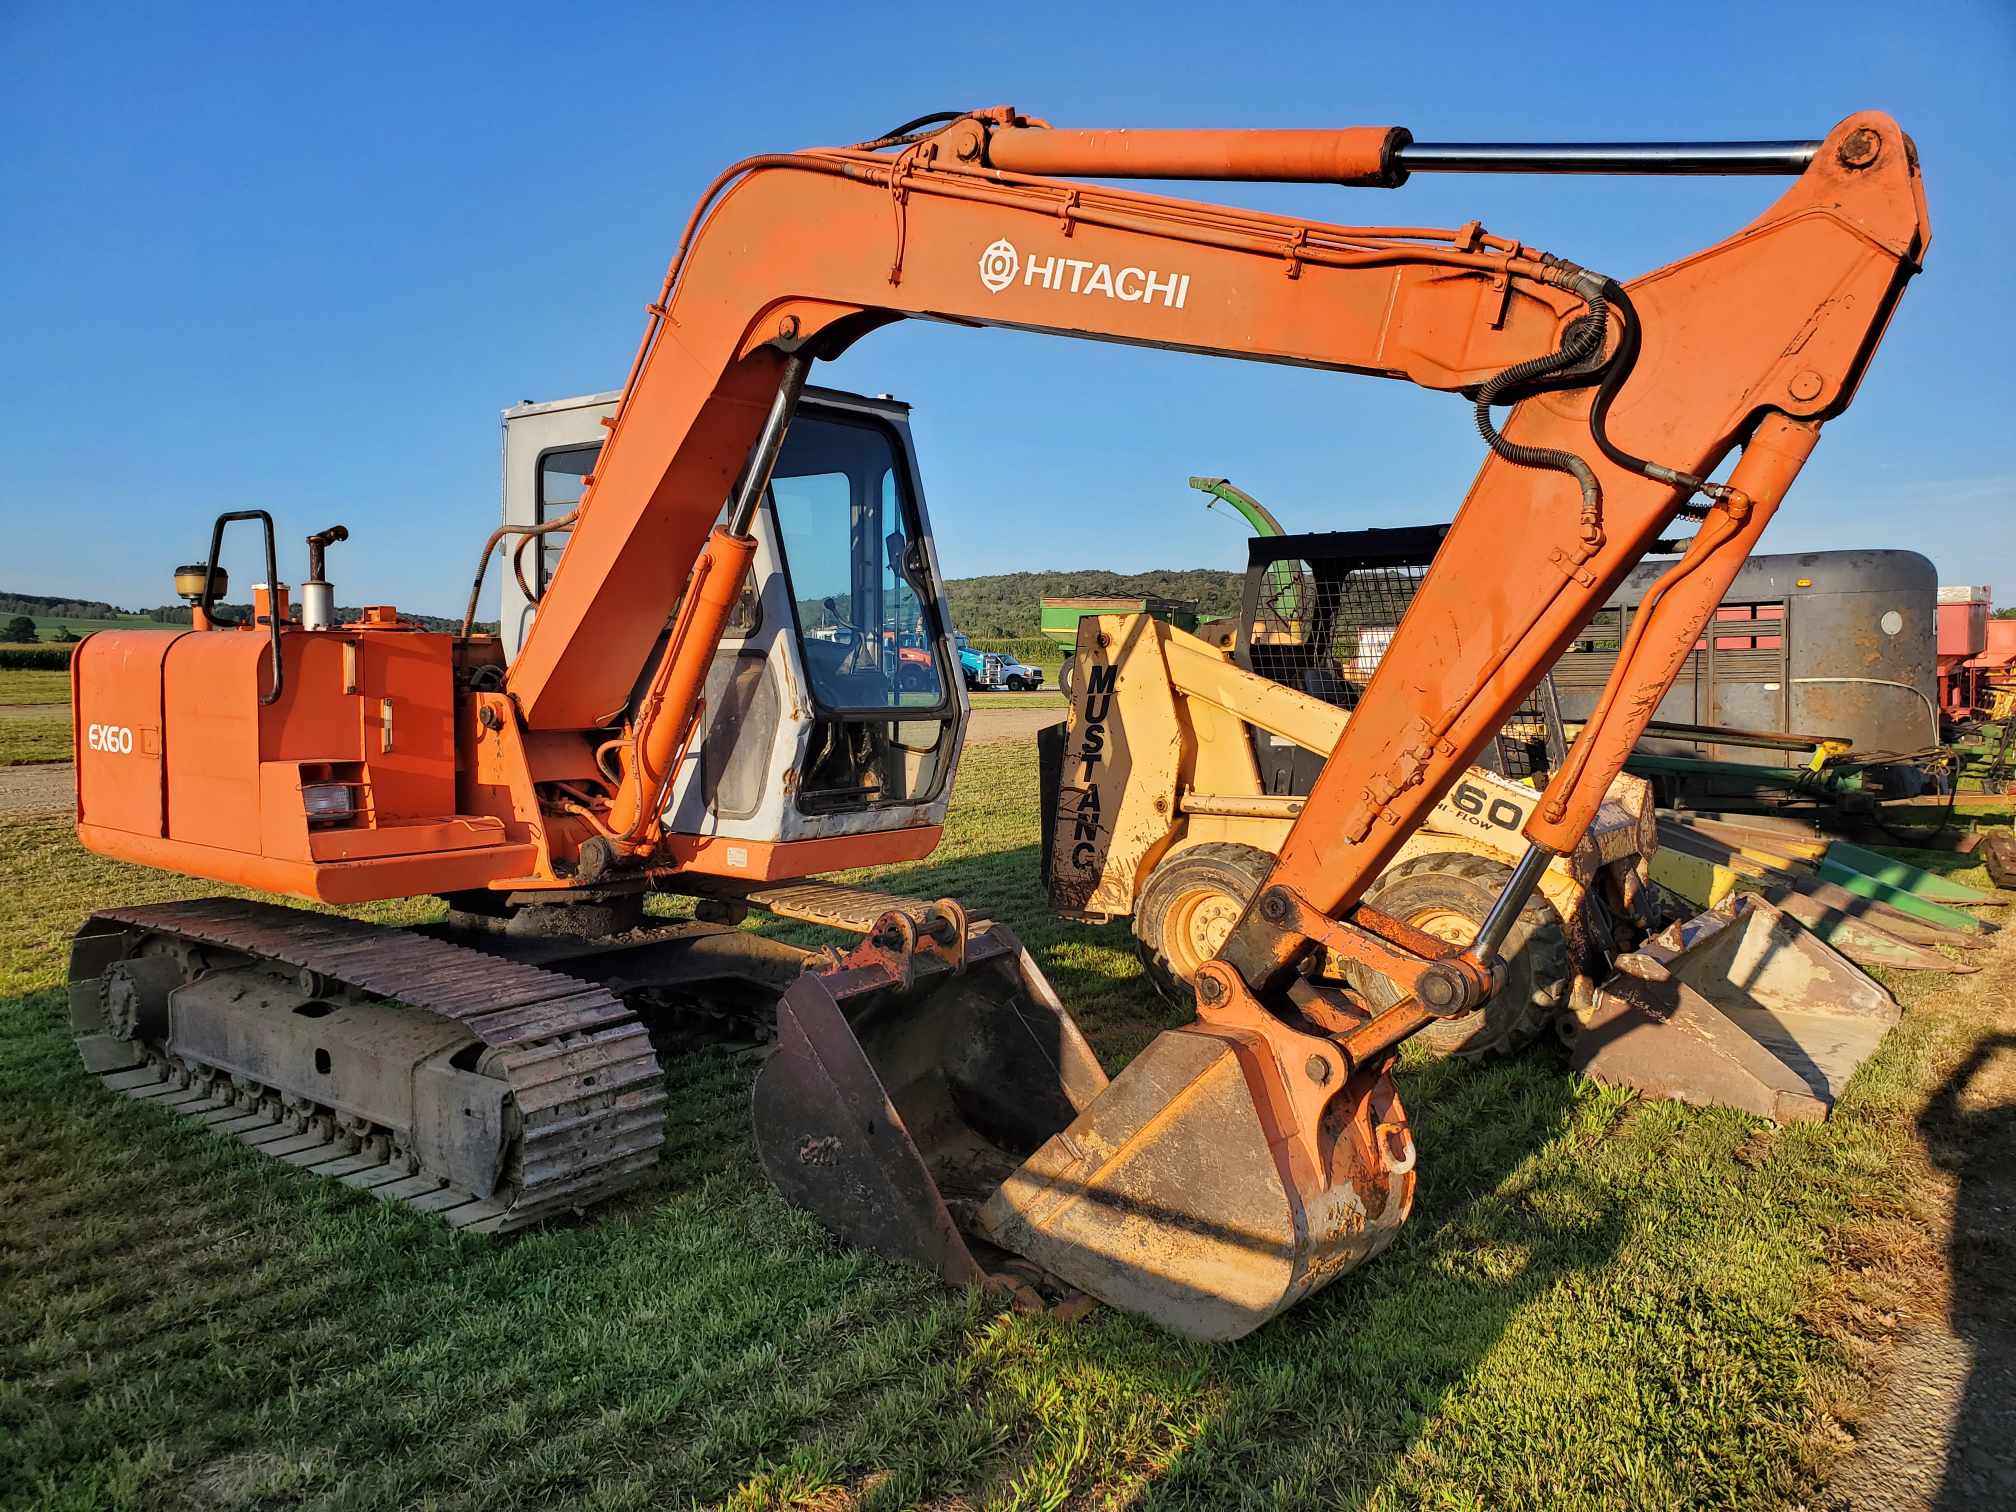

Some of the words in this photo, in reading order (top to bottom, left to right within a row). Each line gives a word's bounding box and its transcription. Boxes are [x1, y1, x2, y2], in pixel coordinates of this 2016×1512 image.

[1023, 254, 1191, 309] HITACHI
[88, 723, 133, 754] EX60
[1071, 664, 1118, 870] MUSTANG
[1455, 811, 1494, 830] FLOW
